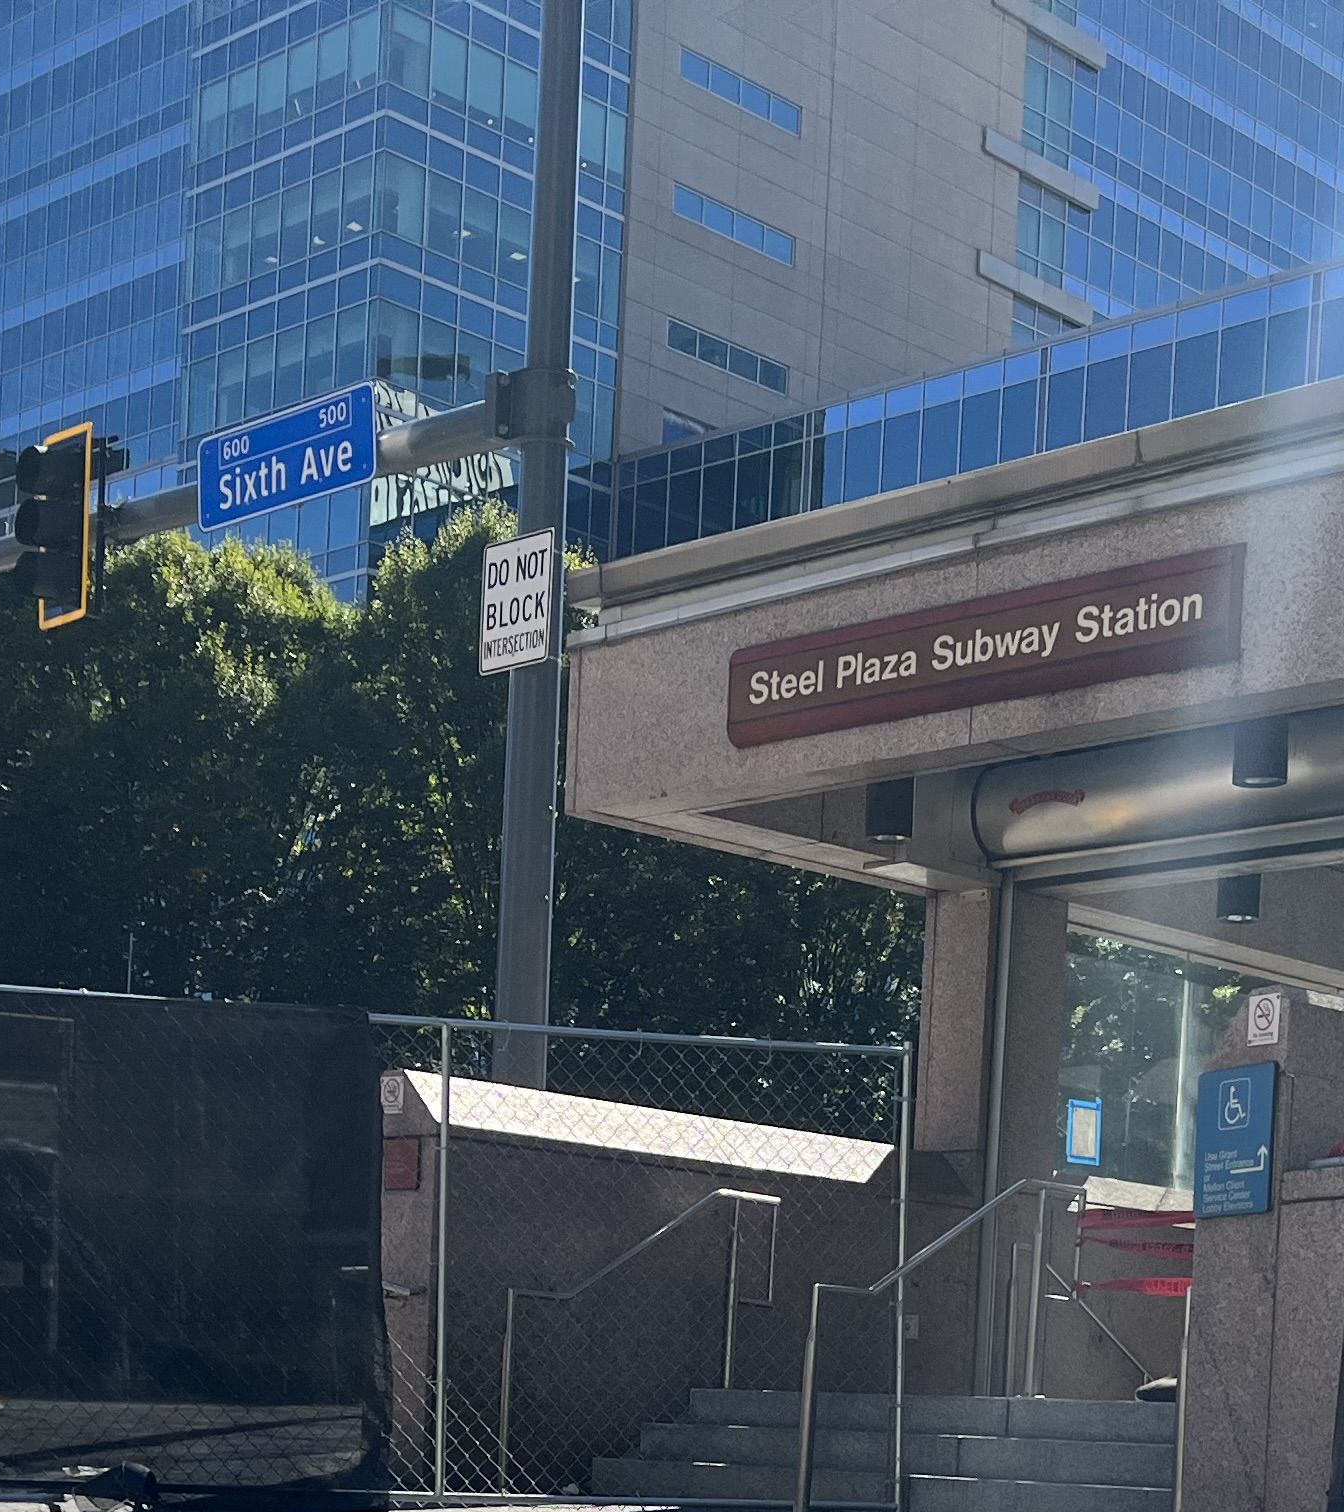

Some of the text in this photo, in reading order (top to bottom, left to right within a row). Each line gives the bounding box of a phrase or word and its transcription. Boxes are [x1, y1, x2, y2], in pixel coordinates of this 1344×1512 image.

[223, 402, 346, 460] 600 500
[219, 441, 353, 510] Sixth Ave
[488, 548, 547, 589] DO NOT
[487, 590, 545, 631] BLOCK
[484, 629, 545, 659] INTERSECTION
[749, 592, 1203, 704] Steel Plaza Subway Station
[1204, 1160, 1254, 1172] Street Entrance
